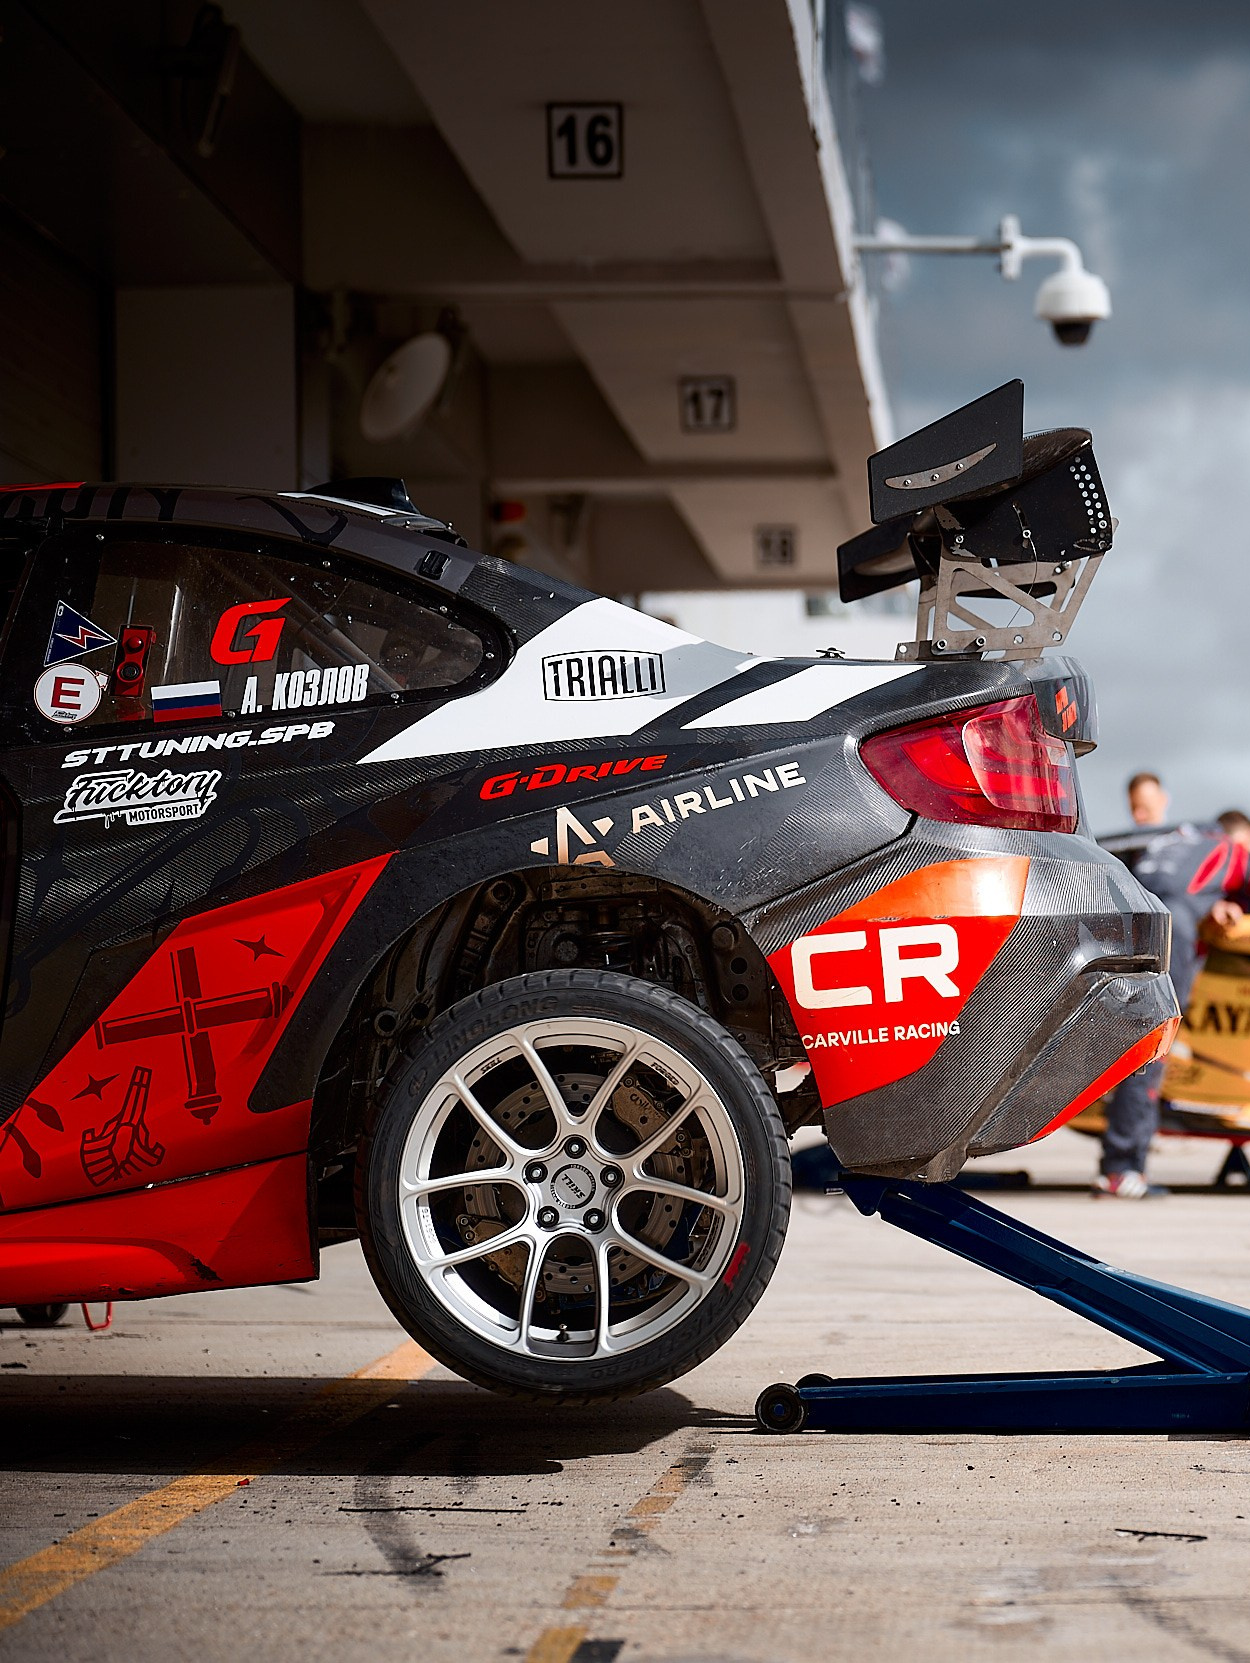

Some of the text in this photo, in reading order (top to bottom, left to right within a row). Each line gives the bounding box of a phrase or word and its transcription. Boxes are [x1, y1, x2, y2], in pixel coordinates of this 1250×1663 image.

[555, 113, 615, 167] 16
[686, 387, 725, 424] 17
[51, 676, 84, 710] E
[241, 663, 370, 715] А. КОЗЛОВ
[547, 654, 658, 697] TRIALLI
[61, 721, 336, 769] STTUNING.SPB
[128, 803, 200, 823] MOTORSPORT
[631, 762, 807, 834] AIRLINE
[790, 922, 961, 1010] CR
[801, 1020, 961, 1050] CARVILLE RACING
